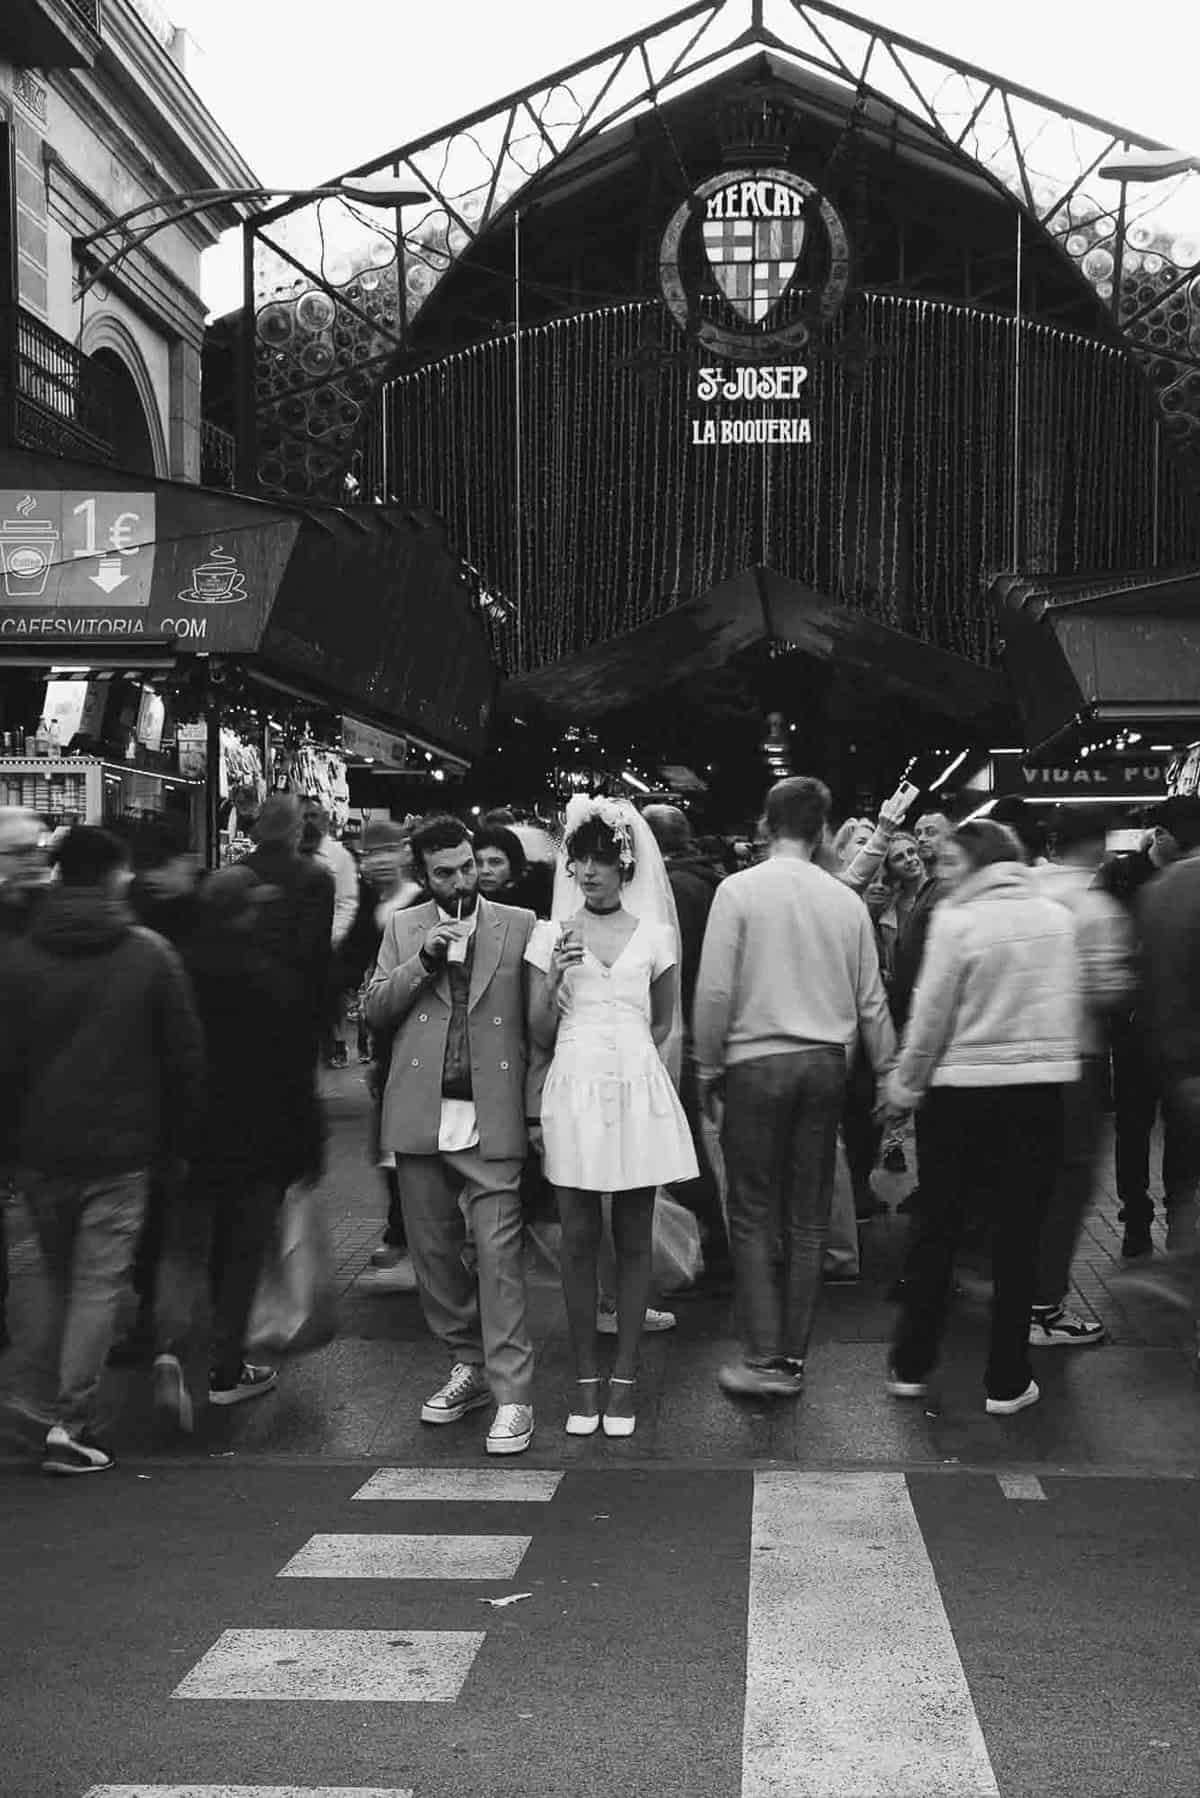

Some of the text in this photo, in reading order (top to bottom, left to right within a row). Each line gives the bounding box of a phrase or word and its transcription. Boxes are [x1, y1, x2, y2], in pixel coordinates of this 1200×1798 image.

[706, 180, 804, 218] MERCAT
[722, 366, 808, 400] JOSEP
[692, 418, 812, 444] LA BOQUERIA
[1022, 766, 1109, 783] VIDAL
